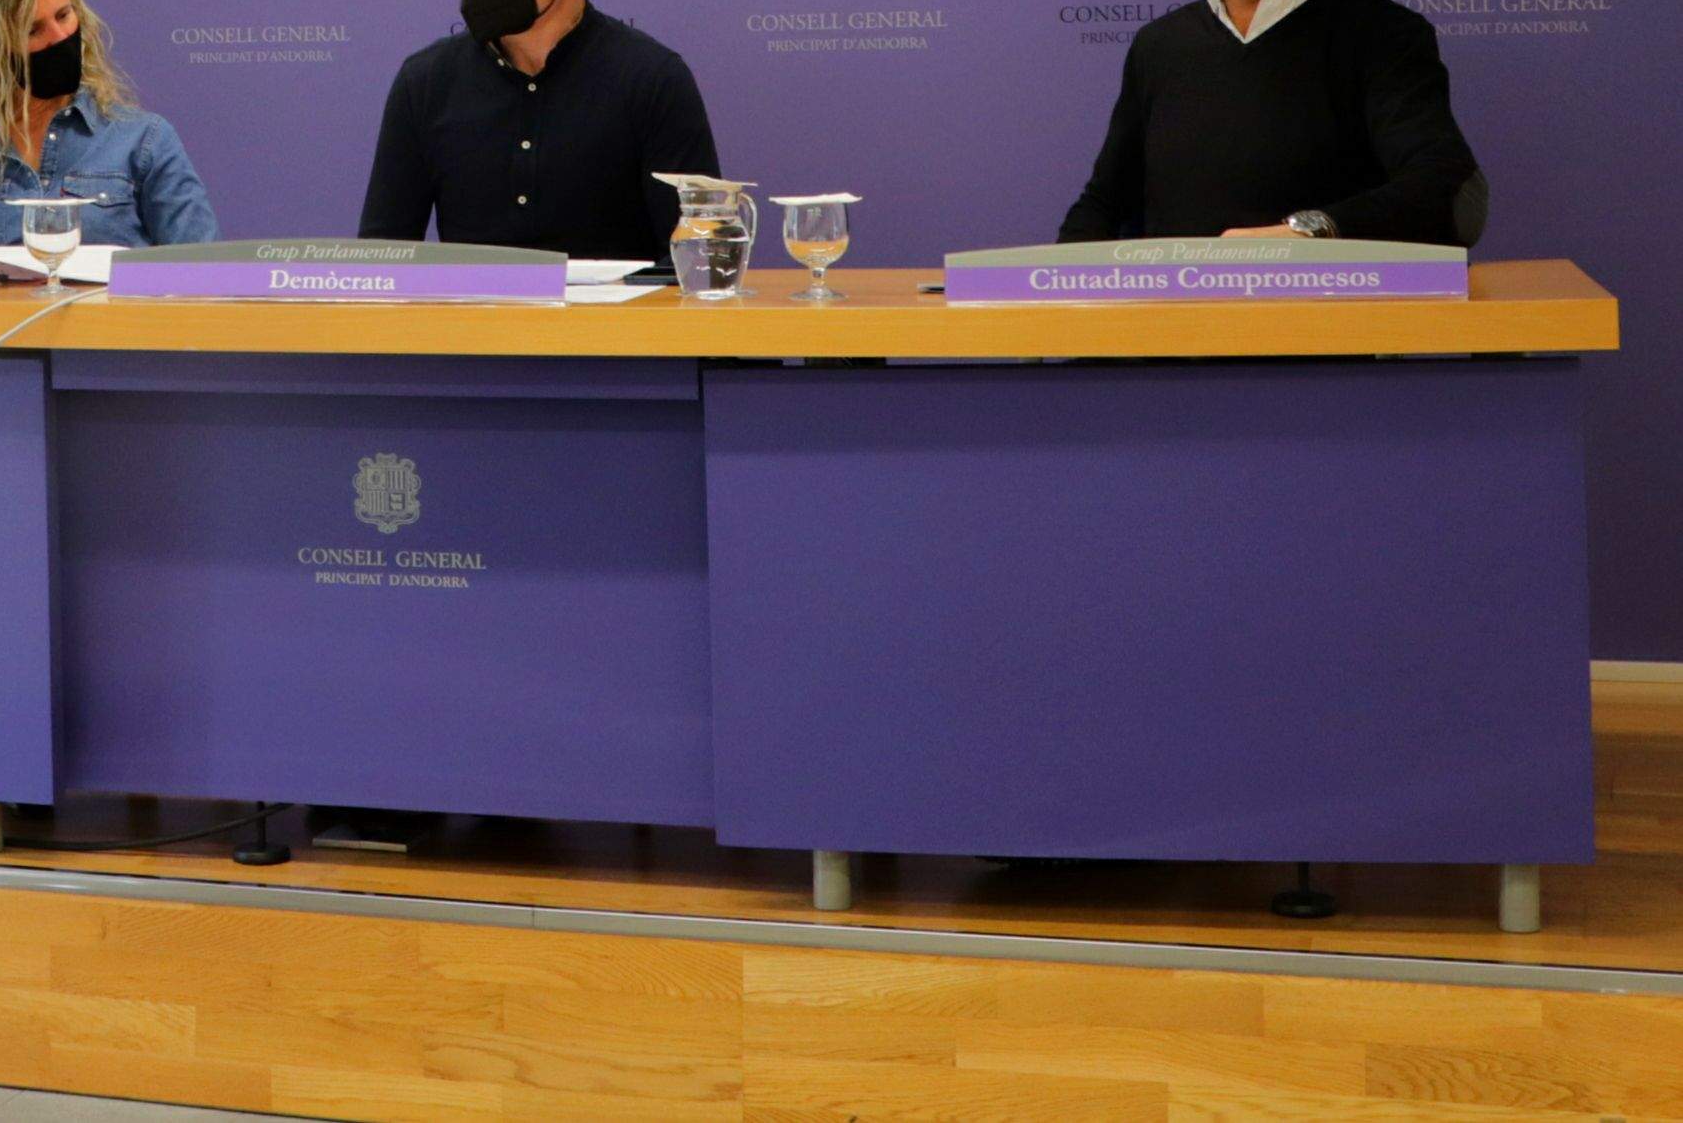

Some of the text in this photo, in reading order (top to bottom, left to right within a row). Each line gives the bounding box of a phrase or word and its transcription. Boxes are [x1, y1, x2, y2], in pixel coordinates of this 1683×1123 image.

[746, 9, 948, 32] CONSELL GENERAL
[1059, 3, 1156, 24] CONSELL
[170, 24, 351, 46] CONSELL GENERAL
[1495, 20, 1590, 35] D'ANDORRA
[767, 36, 929, 53] PRINCIPAT D'ANDORRA
[189, 49, 334, 65] PRINCIPAT D'ANDORRA
[256, 244, 416, 262] Grup Parlamentari
[1113, 242, 1293, 262] Grup Parlamentari
[269, 269, 397, 291] Demòcrata
[1029, 266, 1381, 295] Ciutadans Compromesos
[297, 547, 487, 570] CONSELL GENERAL
[316, 571, 469, 589] PRINCIPAT D'ANDORRA
